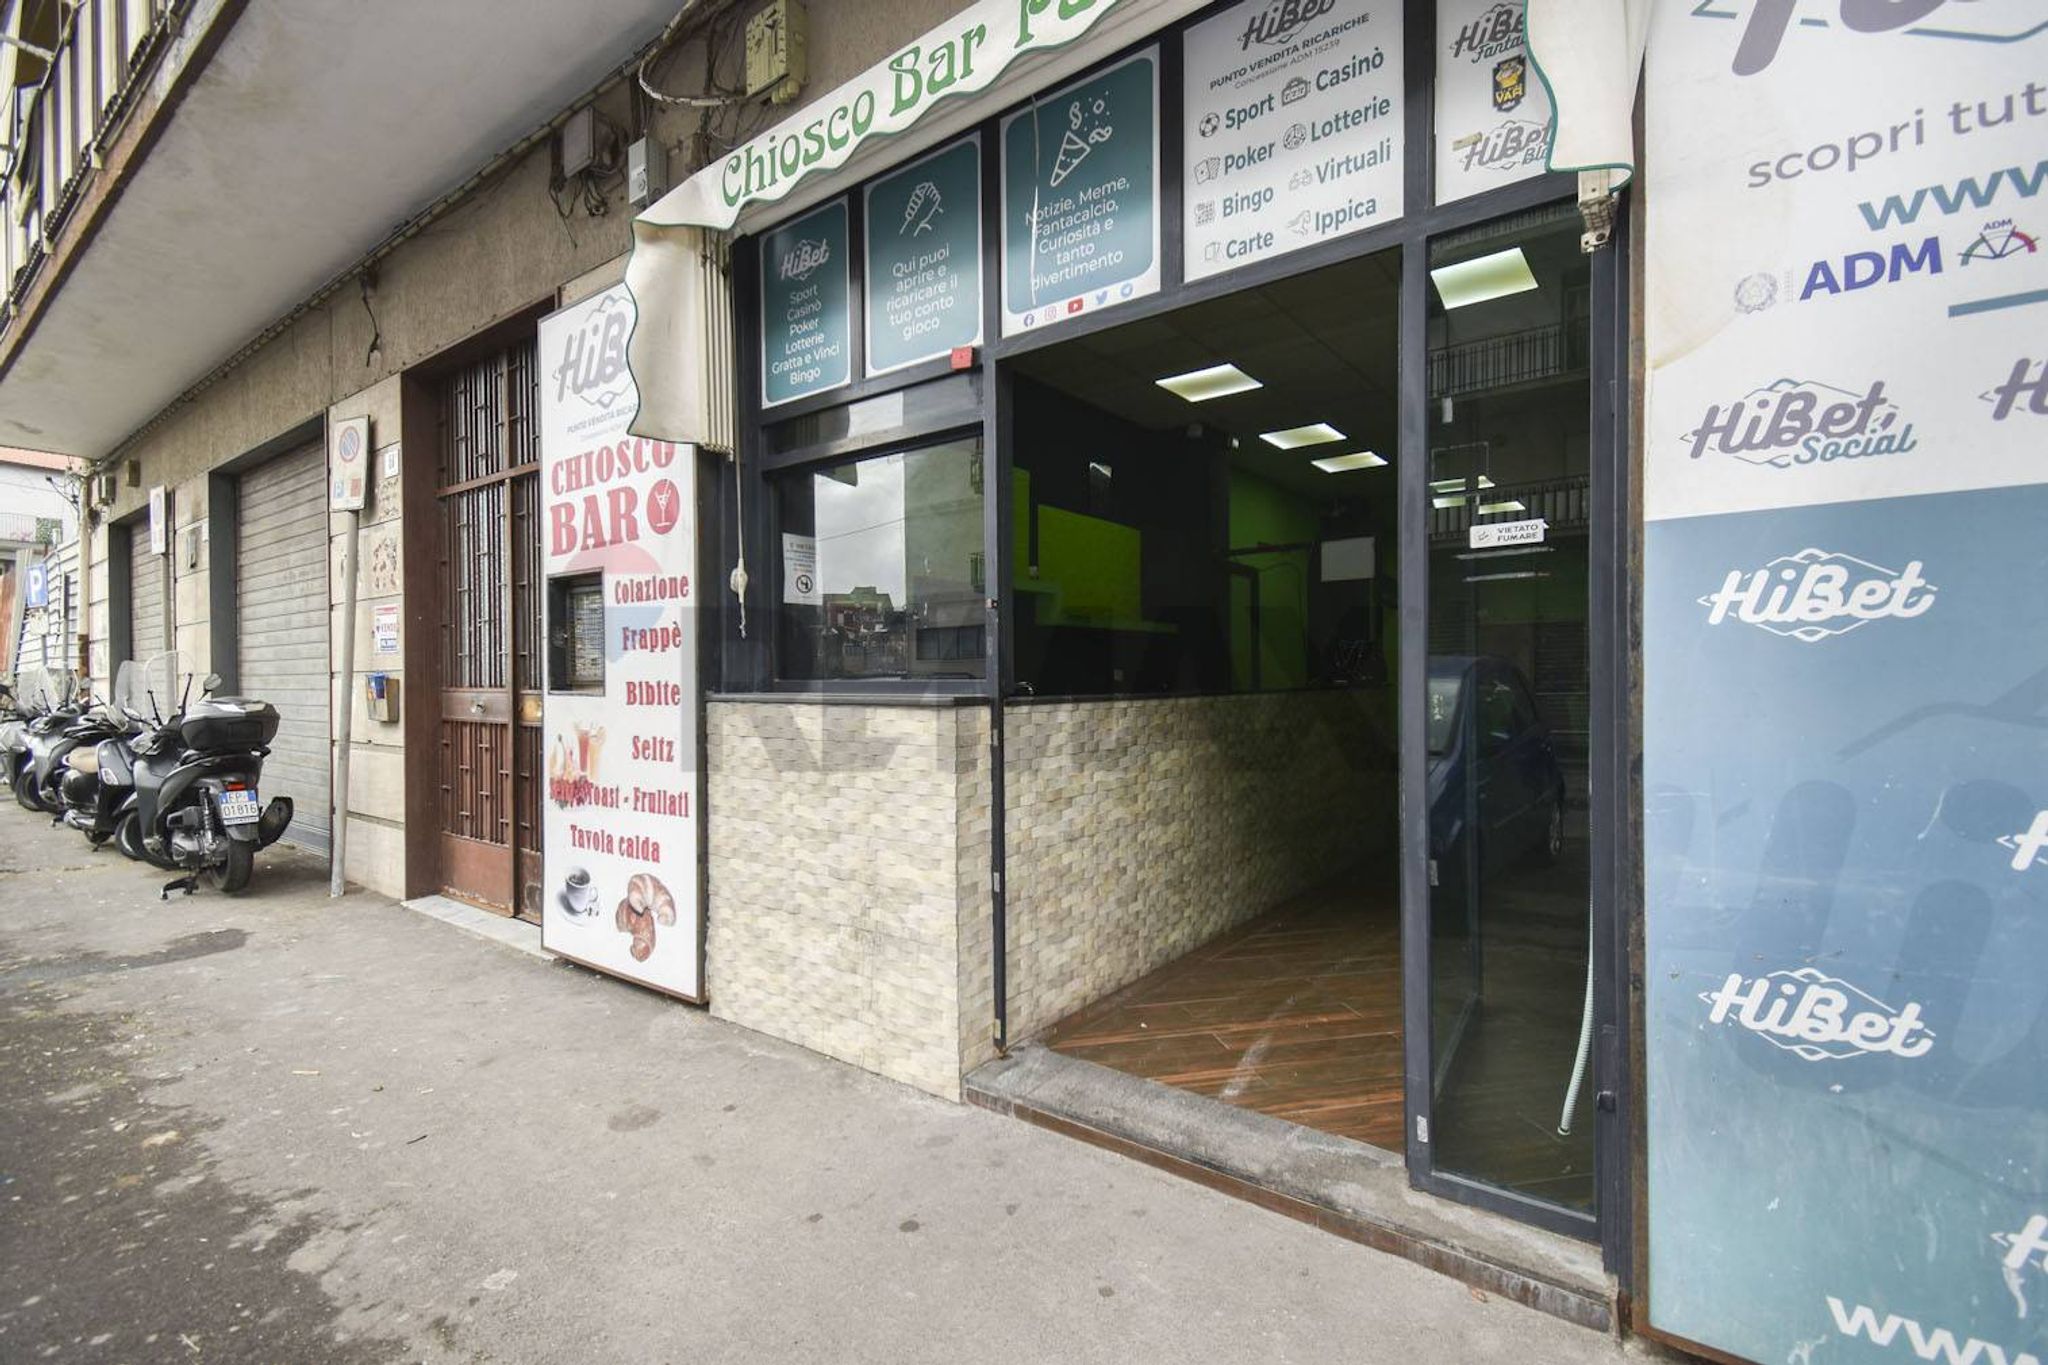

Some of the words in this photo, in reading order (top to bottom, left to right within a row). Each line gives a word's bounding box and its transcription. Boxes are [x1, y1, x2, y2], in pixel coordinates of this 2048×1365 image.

[1209, 67, 1247, 91] PUNTO
[1249, 45, 1300, 71] VENDITA
[1302, 13, 1370, 49] RICARICHE
[1290, 51, 1313, 66] ADM
[1225, 93, 1275, 130] Sport
[1315, 46, 1384, 92] Casinò
[722, 89, 875, 207] Chiosco
[888, 24, 987, 117] Bar
[1224, 141, 1275, 175] Poker
[1311, 95, 1391, 142] Lotterie
[1748, 108, 1925, 189] scopri
[1223, 186, 1274, 217] Bingo
[1315, 138, 1391, 185] Virtuali
[1025, 197, 1076, 227] Notizie,
[1080, 177, 1130, 205] Meme,
[1034, 199, 1119, 240] Fantacalcio,
[1039, 220, 1101, 254] Curiosità
[1104, 218, 1114, 230] e
[1226, 230, 1274, 259] Carte
[1315, 198, 1377, 234] Ippica
[1983, 218, 2013, 232] ADM
[780, 238, 829, 281] HiBet
[893, 256, 916, 278] Qui
[920, 242, 949, 271] puoi
[1031, 250, 1124, 291] divertimento
[1056, 242, 1095, 265] tanto
[1800, 236, 1943, 301] ADM
[790, 284, 818, 305] Sport
[887, 281, 947, 312] ricaricare
[950, 272, 958, 289] il
[896, 269, 934, 293] aprire
[938, 264, 946, 277] e
[789, 317, 819, 337] Poker
[890, 310, 911, 326] tuo
[915, 295, 954, 318] conto
[785, 331, 825, 354] Lotterie
[903, 316, 940, 342] gioco
[771, 355, 803, 375] Gratta
[804, 353, 812, 364] e
[814, 340, 840, 361] Vinci
[790, 366, 821, 385] Bingo
[1690, 381, 1900, 459] HiBet
[1794, 424, 1917, 466] Social
[550, 486, 640, 557] BAR
[1497, 523, 1539, 534] VIETATO
[1497, 532, 1538, 542] FUMARE
[30, 568, 43, 603] P
[614, 575, 690, 605] Colazione
[1709, 560, 1935, 625] HiBet
[621, 621, 682, 652] Frappè
[625, 680, 681, 707] Bibite
[632, 735, 675, 763] Seltz
[633, 786, 690, 818] Frullati
[570, 824, 614, 855] Tavola
[618, 835, 661, 863] calda
[1709, 973, 1933, 1057] HiBet
